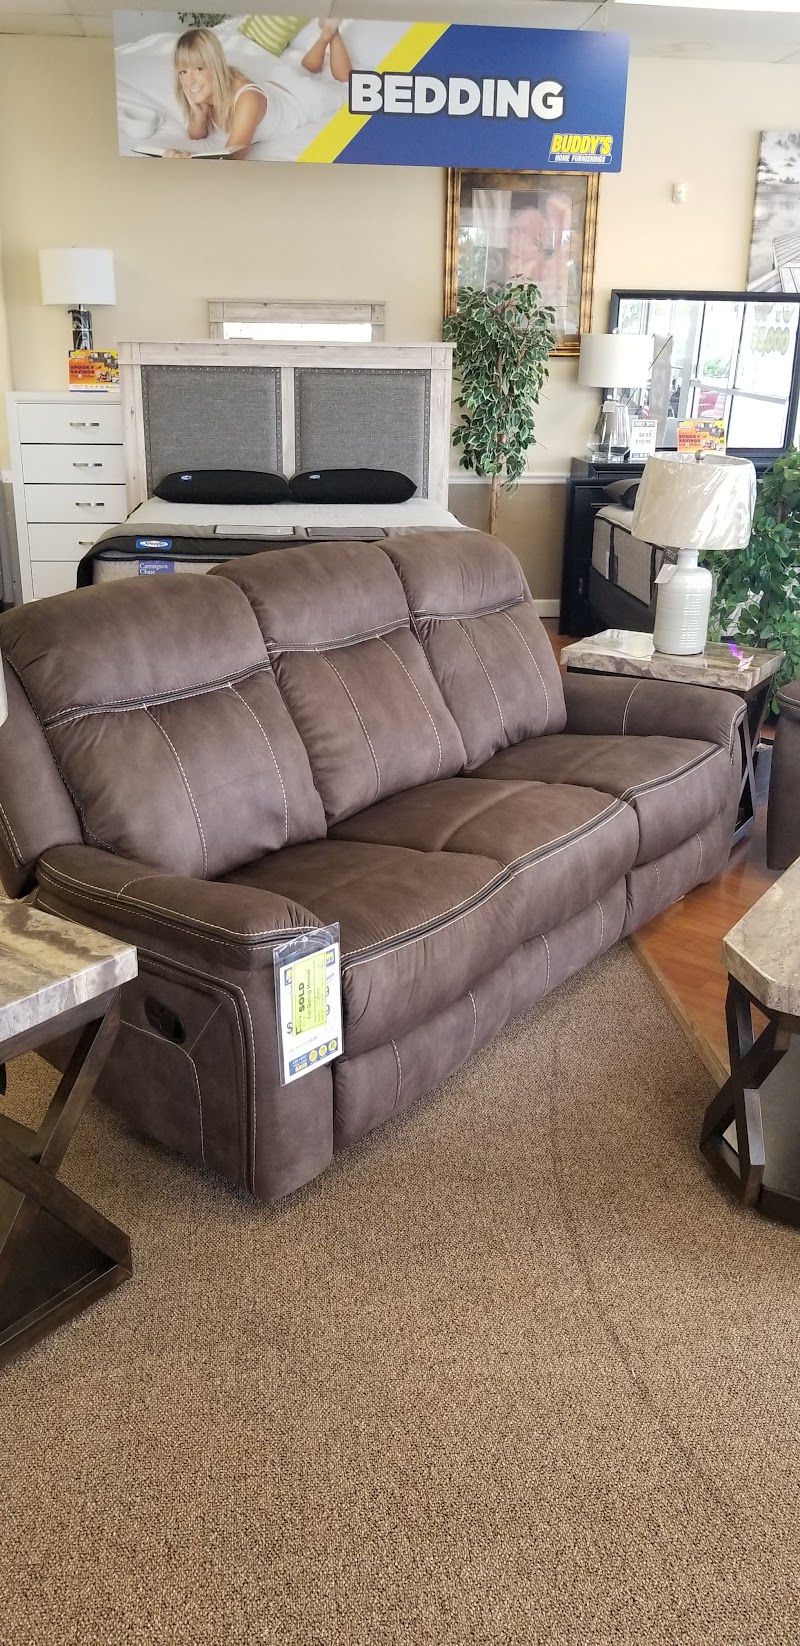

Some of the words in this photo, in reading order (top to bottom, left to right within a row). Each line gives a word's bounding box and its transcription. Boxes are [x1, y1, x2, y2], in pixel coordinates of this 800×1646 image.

[350, 72, 564, 120] BEDDING
[551, 134, 613, 155] BUDDY'S
[571, 155, 606, 163] FURNISHINGS
[298, 982, 306, 1013] SOLD
